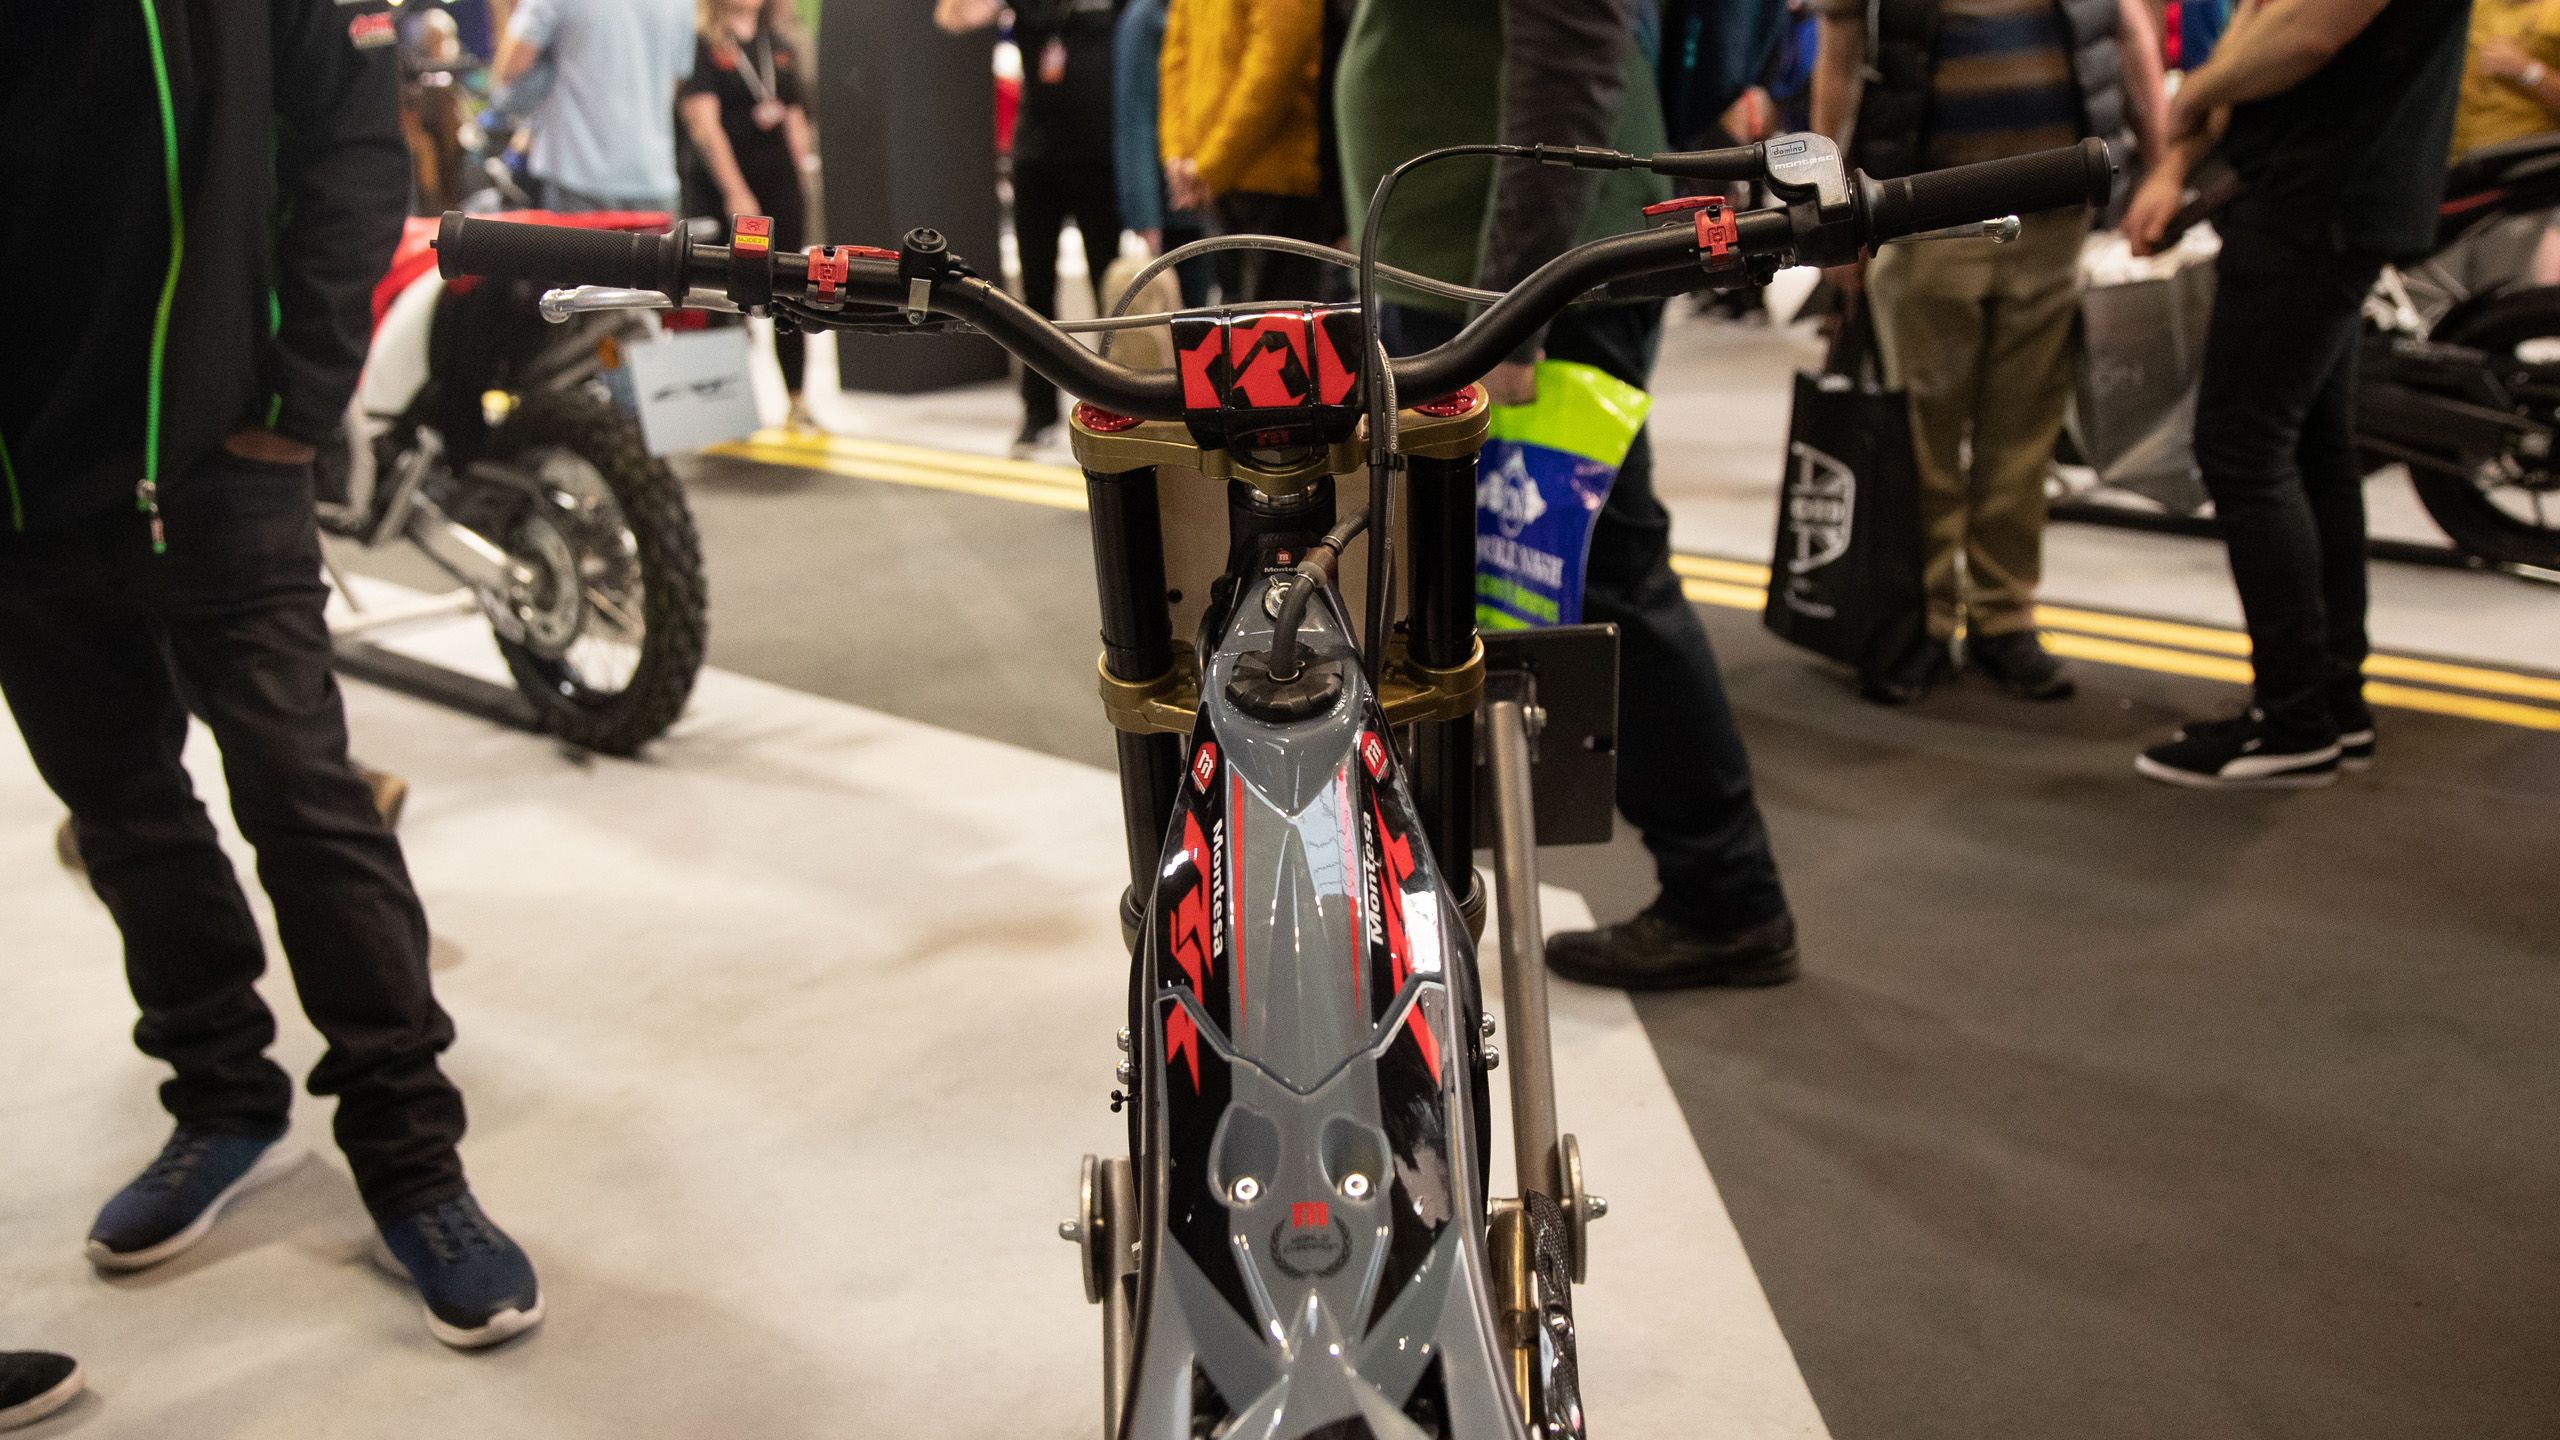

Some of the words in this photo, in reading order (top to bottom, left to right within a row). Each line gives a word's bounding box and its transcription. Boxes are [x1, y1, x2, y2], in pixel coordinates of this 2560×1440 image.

[1773, 145, 1803, 156] domino
[1213, 818, 1225, 959] Montesa
[1363, 811, 1384, 945] Montesa
